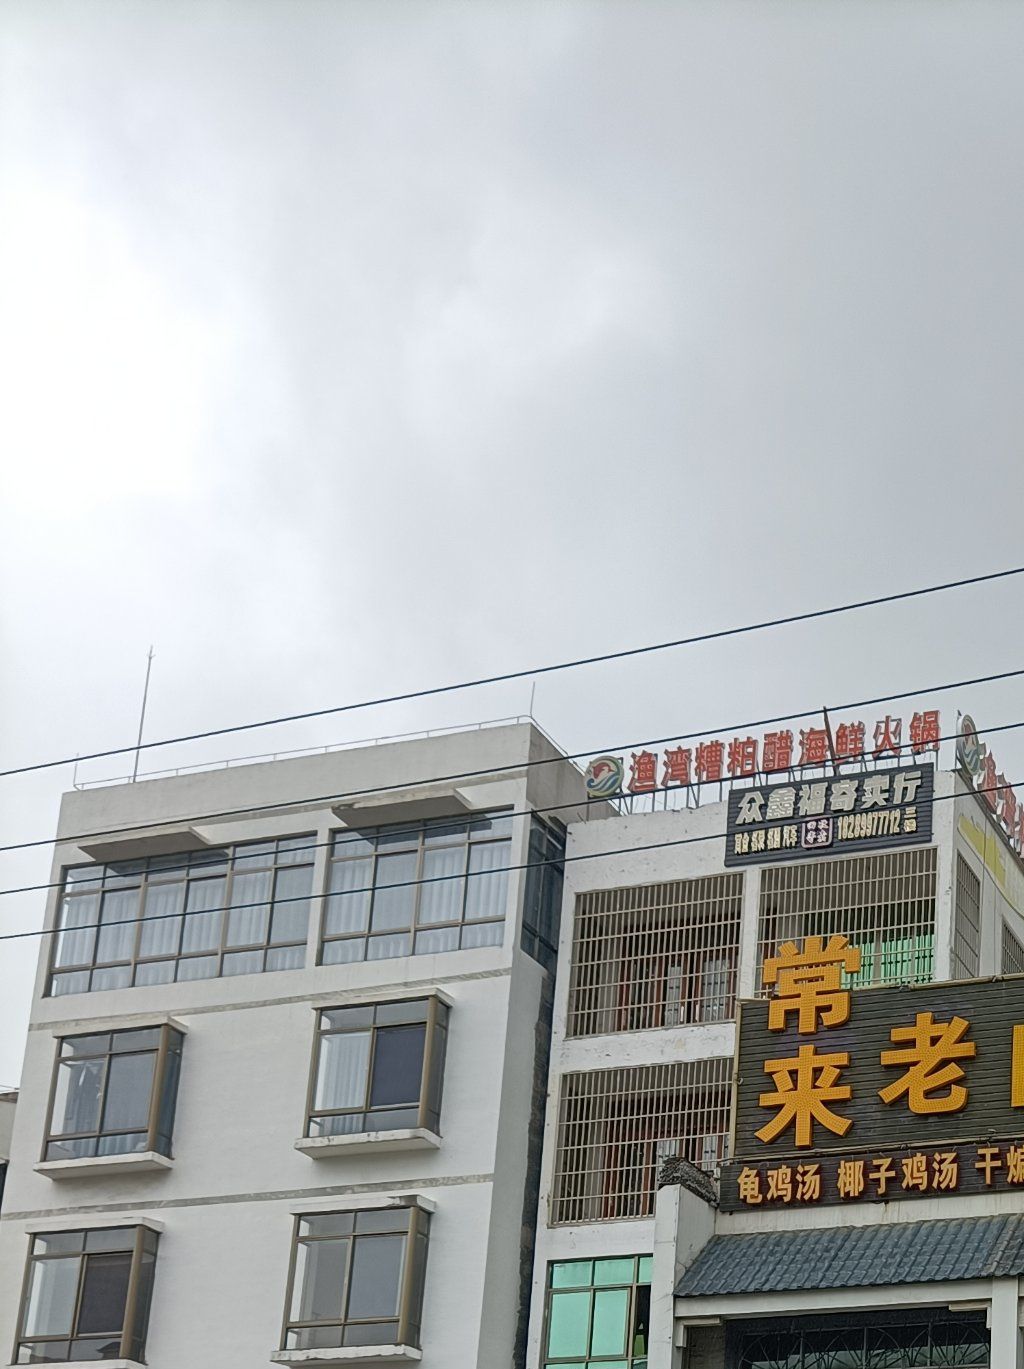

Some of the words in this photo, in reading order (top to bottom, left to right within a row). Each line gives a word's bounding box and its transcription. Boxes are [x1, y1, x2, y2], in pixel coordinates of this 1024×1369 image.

[754, 935, 861, 1147] 常来
[738, 1163, 821, 1205] 龟鸡汤
[837, 1151, 959, 1199] 椰子鸡汤
